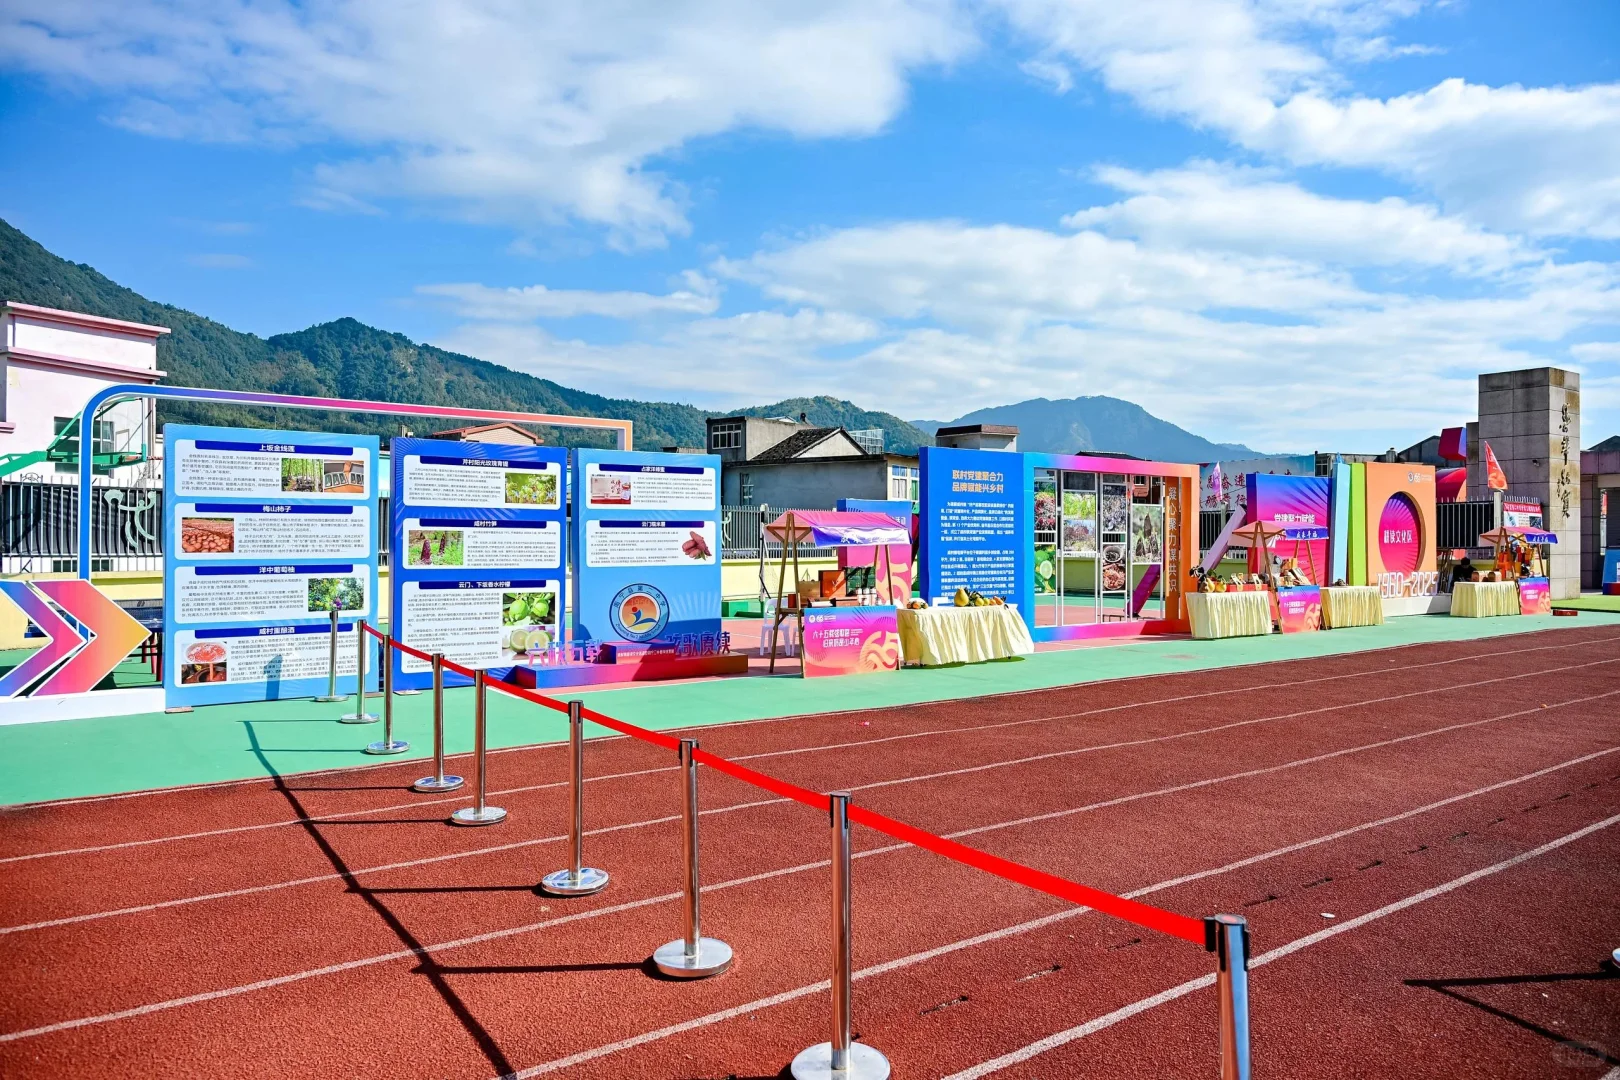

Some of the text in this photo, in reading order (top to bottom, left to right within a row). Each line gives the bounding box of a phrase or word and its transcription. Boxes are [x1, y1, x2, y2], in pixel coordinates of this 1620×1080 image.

[952, 470, 1004, 482] 联村党建聚合力
[952, 482, 1004, 494] 品牌赋能兴乡村
[262, 505, 292, 513] 梅山柿子
[1168, 486, 1177, 592] 凝心聚力谋共识
[1383, 529, 1413, 544] 耕读文化区
[259, 566, 295, 574] 洋中葡萄柚
